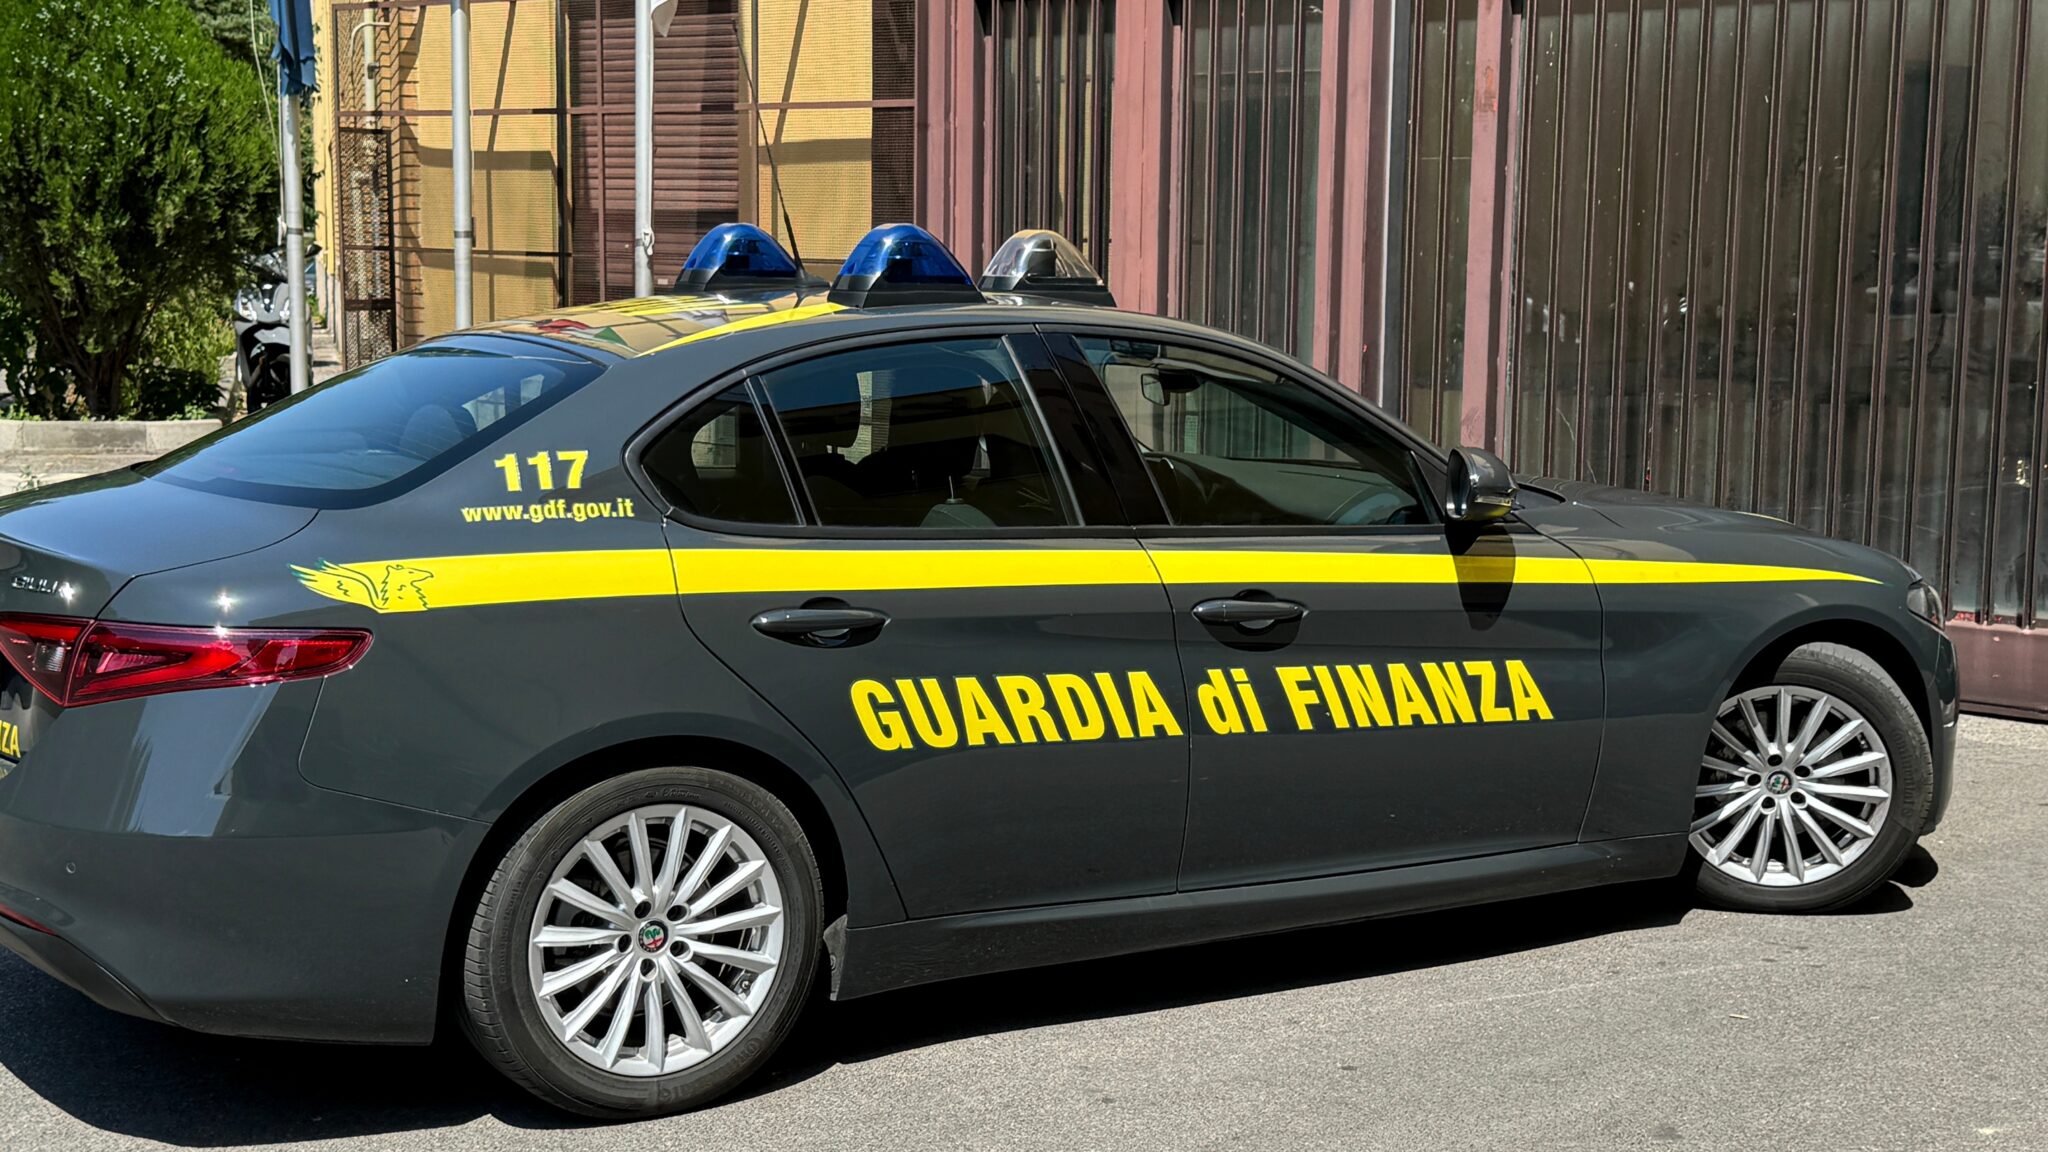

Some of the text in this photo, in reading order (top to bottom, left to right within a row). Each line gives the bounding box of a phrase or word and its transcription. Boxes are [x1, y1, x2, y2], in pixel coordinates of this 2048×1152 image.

[494, 450, 588, 491] 117
[461, 498, 635, 523] www.gdf.gov.it
[850, 659, 1554, 750] GUARDIA di FINANZA
[0, 719, 21, 758] ZA
